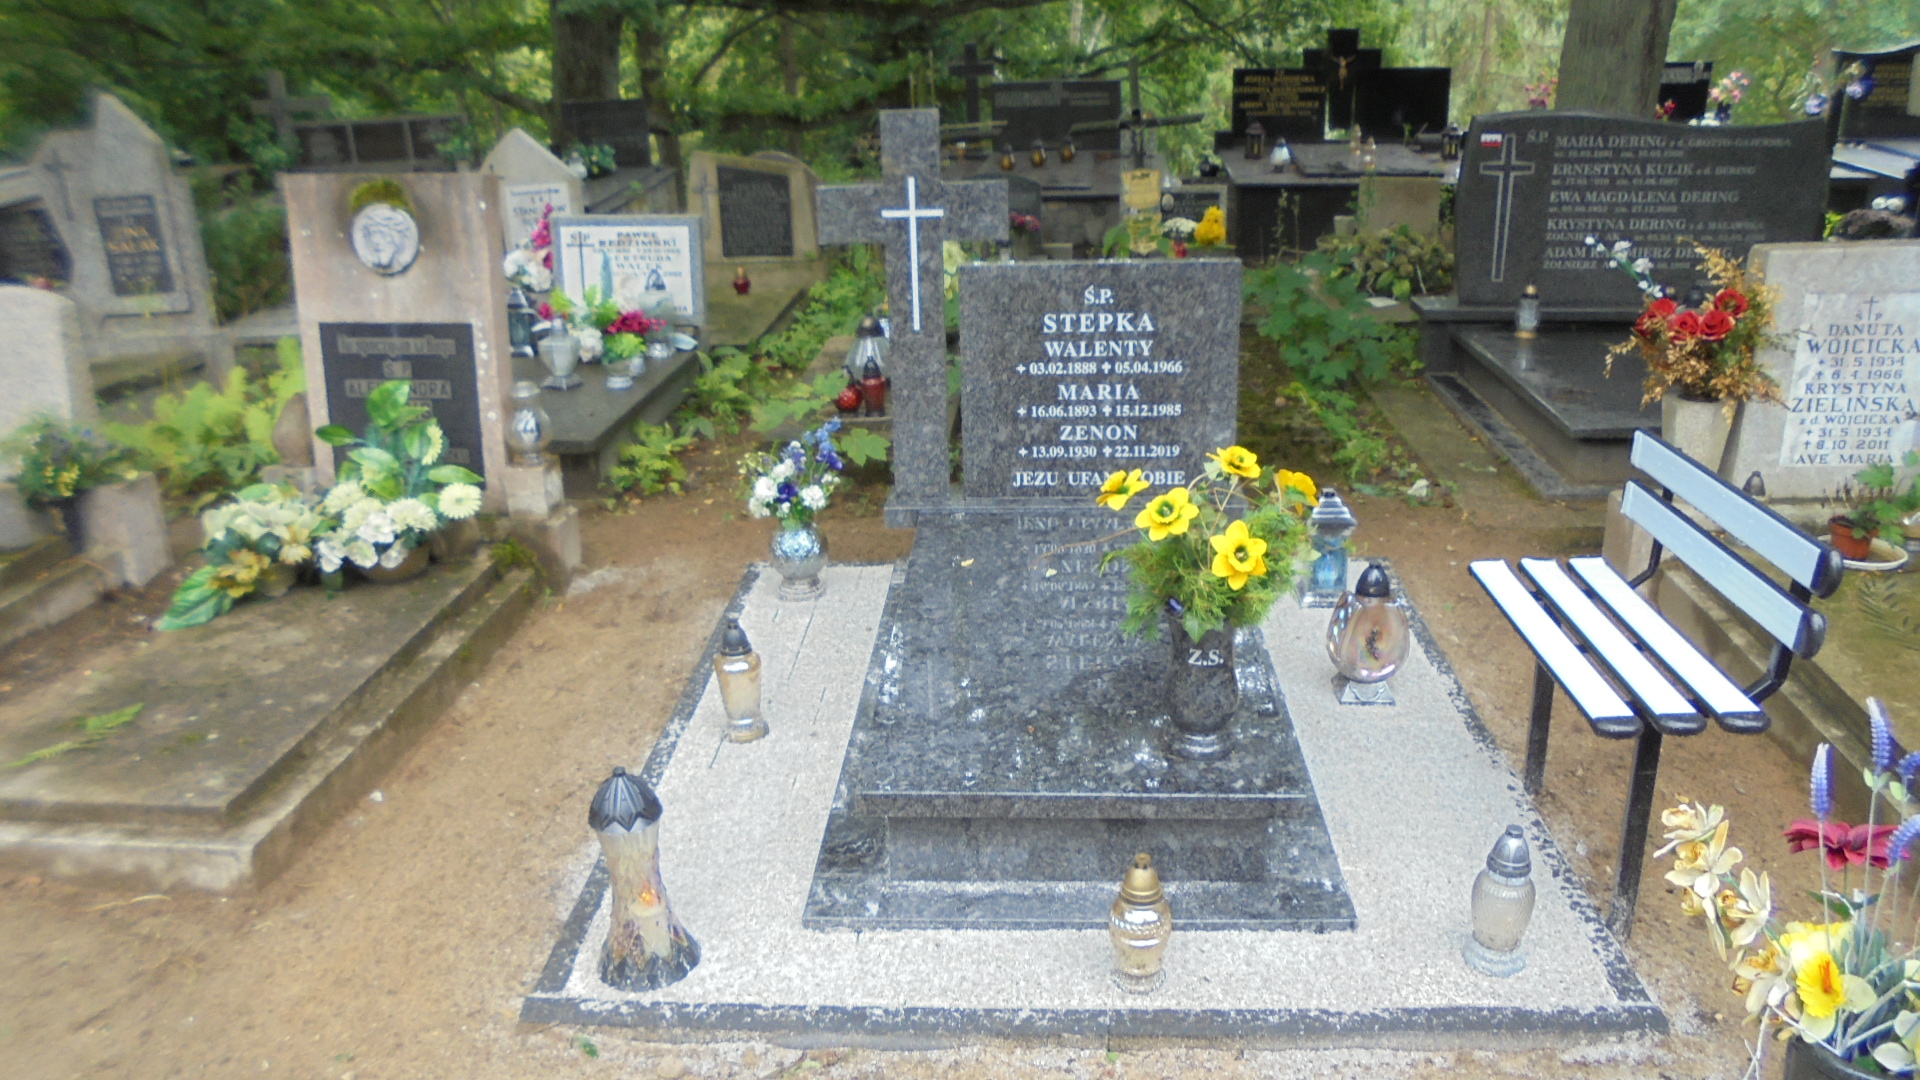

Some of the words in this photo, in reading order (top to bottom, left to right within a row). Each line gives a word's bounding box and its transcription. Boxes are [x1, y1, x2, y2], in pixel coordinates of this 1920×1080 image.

[1556, 135, 1604, 148] MARIA
[1608, 135, 1666, 148] DERING
[1552, 163, 1641, 175] ERNESTYNA
[1646, 163, 1694, 175] KULIK
[1549, 191, 1581, 203] EWA
[1584, 191, 1676, 203] MAGDALENA
[1680, 191, 1740, 203] DERING
[1547, 219, 1624, 231] KRYSTYNA
[1629, 219, 1687, 230] DERING
[1545, 247, 1586, 258] ADAM
[1590, 247, 1672, 258] KAMIERZ
[1084, 285, 1114, 305] Ś.P.
[1043, 313, 1155, 333] STEPKA
[1828, 323, 1904, 336] DANUTA
[1045, 341, 1153, 357] WALENTY
[1806, 337, 1920, 355] WÓJCICKA
[1029, 362, 1097, 375] 03.02.1888
[1114, 361, 1183, 374] 05.04.1966
[349, 382, 448, 397] ALENDRA
[1058, 384, 1140, 400] MARIA
[1804, 382, 1907, 395] KRYSTYNA
[1031, 406, 1097, 418] 16.06.1893
[1115, 404, 1182, 417] 15.12.1985
[1791, 396, 1916, 414] ZIELIŃSKA
[1825, 413, 1901, 427] WÓJCICKA
[1060, 425, 1138, 441] ZENON
[1032, 446, 1097, 458] 13.09.1930
[1114, 445, 1180, 458] 22.11.2019
[1795, 453, 1828, 465] AVE
[1838, 452, 1895, 465] MARIA
[1013, 471, 1059, 487] JEZU
[1130, 470, 1186, 486] OBIE
[1188, 648, 1225, 667] Z.S.
